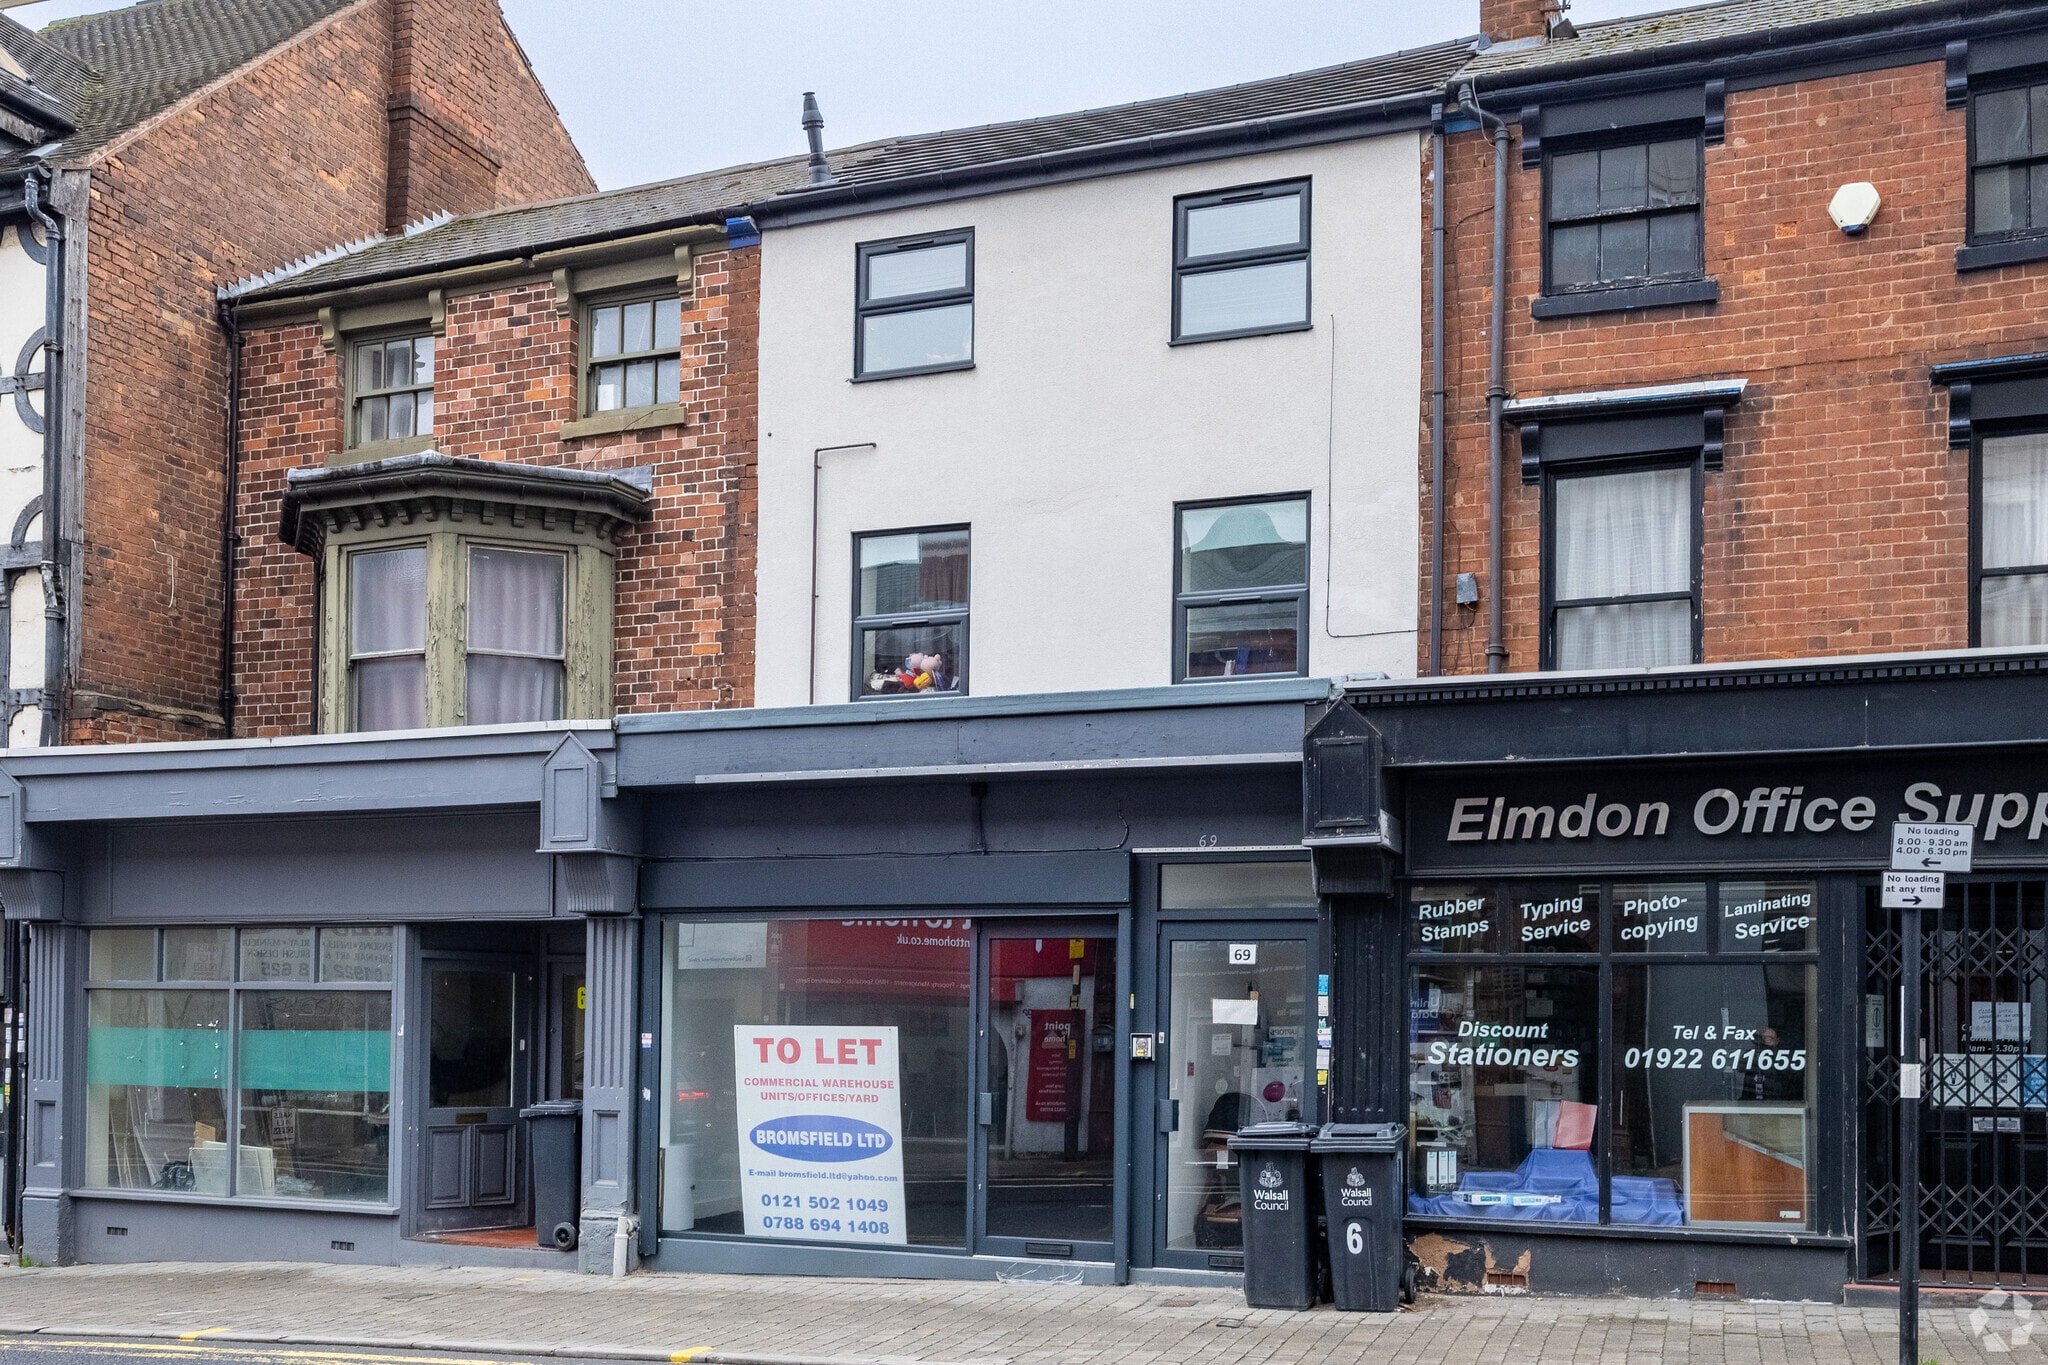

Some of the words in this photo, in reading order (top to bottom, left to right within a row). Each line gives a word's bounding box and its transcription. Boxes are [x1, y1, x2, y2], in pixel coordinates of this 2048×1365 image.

[1447, 793, 1670, 841] Elmdon
[1694, 786, 1876, 835] Office
[1907, 826, 1921, 834] No
[1924, 827, 1960, 836] loading
[1199, 834, 1218, 848] 69
[1897, 837, 1921, 846] 8.00
[1928, 838, 1952, 847] 9.30
[1896, 846, 1920, 855] 4.00
[1927, 847, 1951, 856] 6.30
[1952, 849, 1968, 857] pm
[1887, 874, 1901, 883] No
[1905, 875, 1940, 884] loading
[1885, 885, 1895, 893] at
[1898, 886, 1916, 894] any
[1920, 885, 1941, 893] time
[1419, 897, 1486, 920] Rubber
[1520, 896, 1584, 921] Typing
[1623, 895, 1688, 917] Photo-
[1725, 893, 1812, 918] Laminating
[1421, 920, 1489, 942] Stamps
[1521, 919, 1592, 942] Service
[1621, 915, 1699, 941] copying
[1735, 915, 1810, 940] Service
[1234, 949, 1251, 961] 69
[1458, 1021, 1549, 1038] Discount
[1673, 1025, 1699, 1040] Tel
[1704, 1025, 1717, 1040] &
[1722, 1026, 1757, 1040] Fax
[753, 1037, 801, 1064] TO
[815, 1038, 882, 1065] LET
[1428, 1041, 1580, 1068] Stationers
[1624, 1047, 1703, 1069] 01922
[1711, 1048, 1807, 1070] 611655
[744, 1077, 819, 1088] COMMERCIAL
[822, 1079, 894, 1089] WAREHOUSE
[760, 1092, 879, 1103] UNITS/OFFICES/YARD
[756, 1130, 853, 1147] BROMSFIELD
[857, 1132, 886, 1148] LTD
[749, 1168, 776, 1177] E-mail
[778, 1170, 898, 1182] bromsfield.ltd@yahoo.com
[1253, 1189, 1289, 1200] Walsall
[1341, 1187, 1372, 1198] Walsall
[761, 1194, 801, 1208] 0121
[808, 1196, 840, 1210] 502
[846, 1198, 888, 1212] 1049
[1254, 1200, 1289, 1211] Council
[1341, 1197, 1373, 1207] Council
[763, 1216, 805, 1230] 0788
[809, 1218, 841, 1232] 694
[847, 1220, 890, 1235] 1408
[1346, 1222, 1364, 1255] 6
